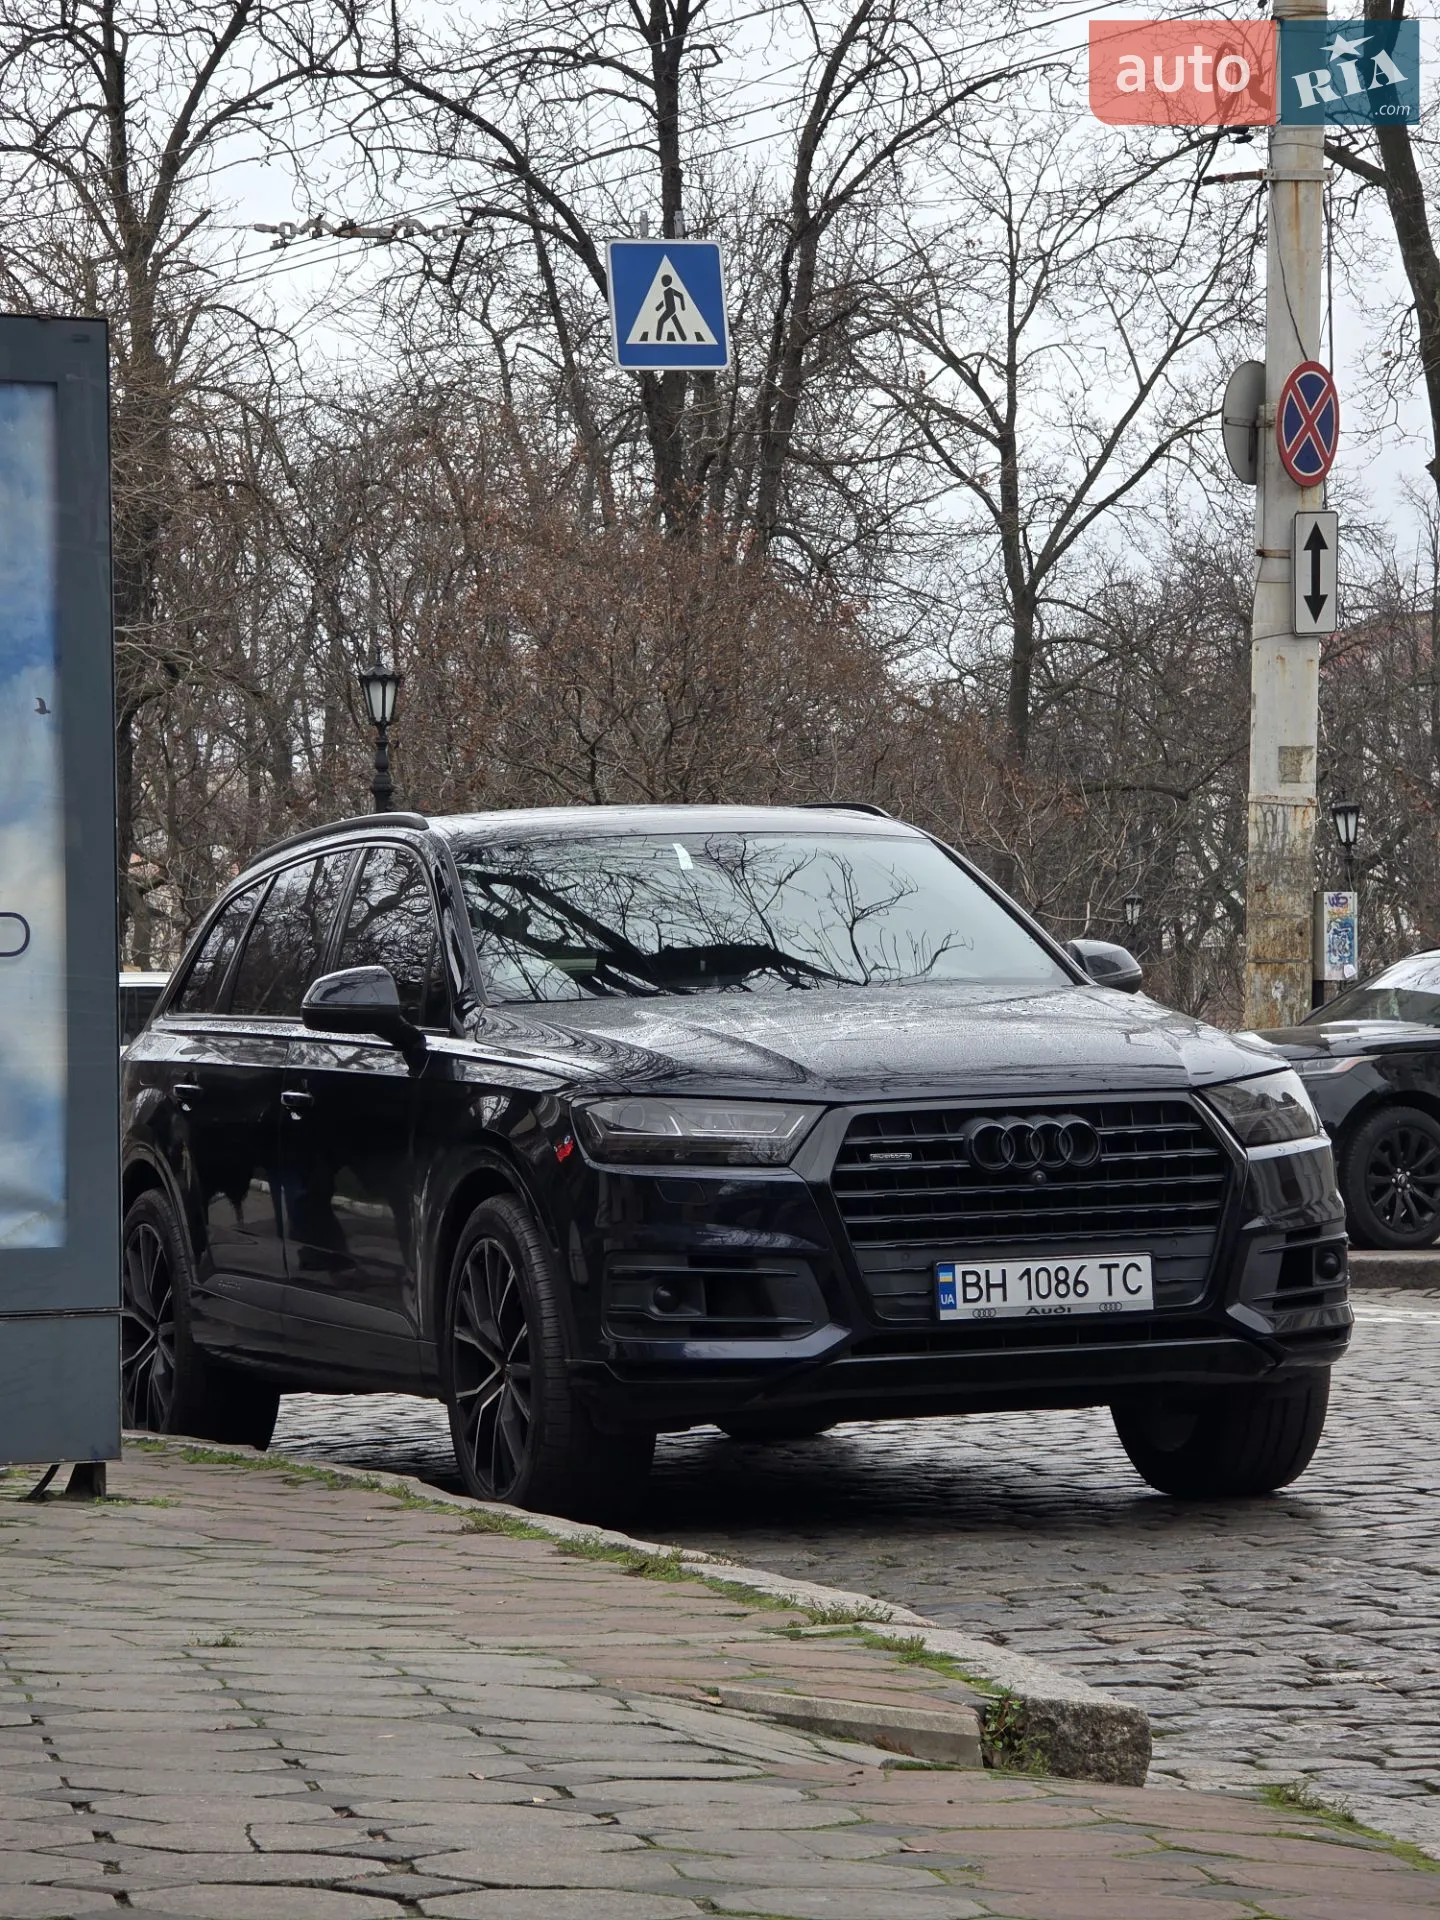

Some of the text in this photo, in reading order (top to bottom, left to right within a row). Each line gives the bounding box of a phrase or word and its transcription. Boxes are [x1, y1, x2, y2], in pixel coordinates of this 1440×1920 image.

[961, 1262, 1143, 1304] BH 1086 TC
[940, 1294, 955, 1305] UA
[1025, 1306, 1072, 1316] Audi
